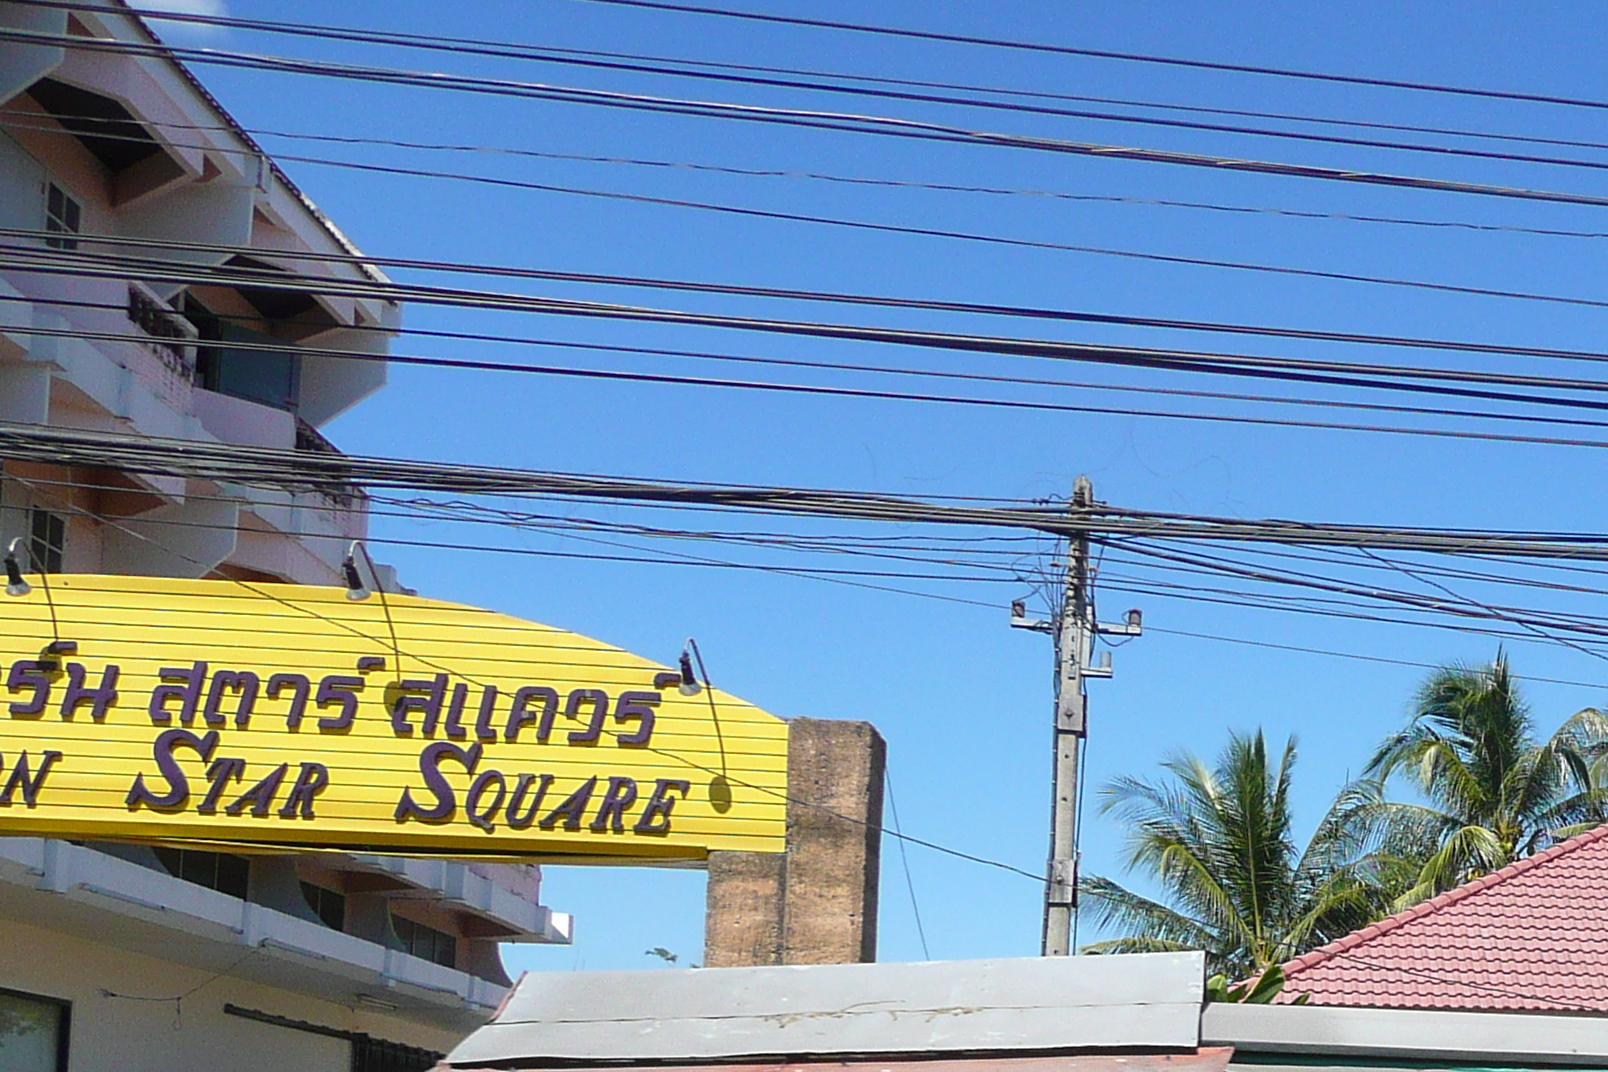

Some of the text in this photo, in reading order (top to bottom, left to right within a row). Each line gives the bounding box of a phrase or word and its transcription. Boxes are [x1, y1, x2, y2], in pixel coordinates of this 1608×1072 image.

[0, 641, 682, 749] ร์น สตาร์ สแควร์
[0, 728, 691, 838] N STAR SQUARE
